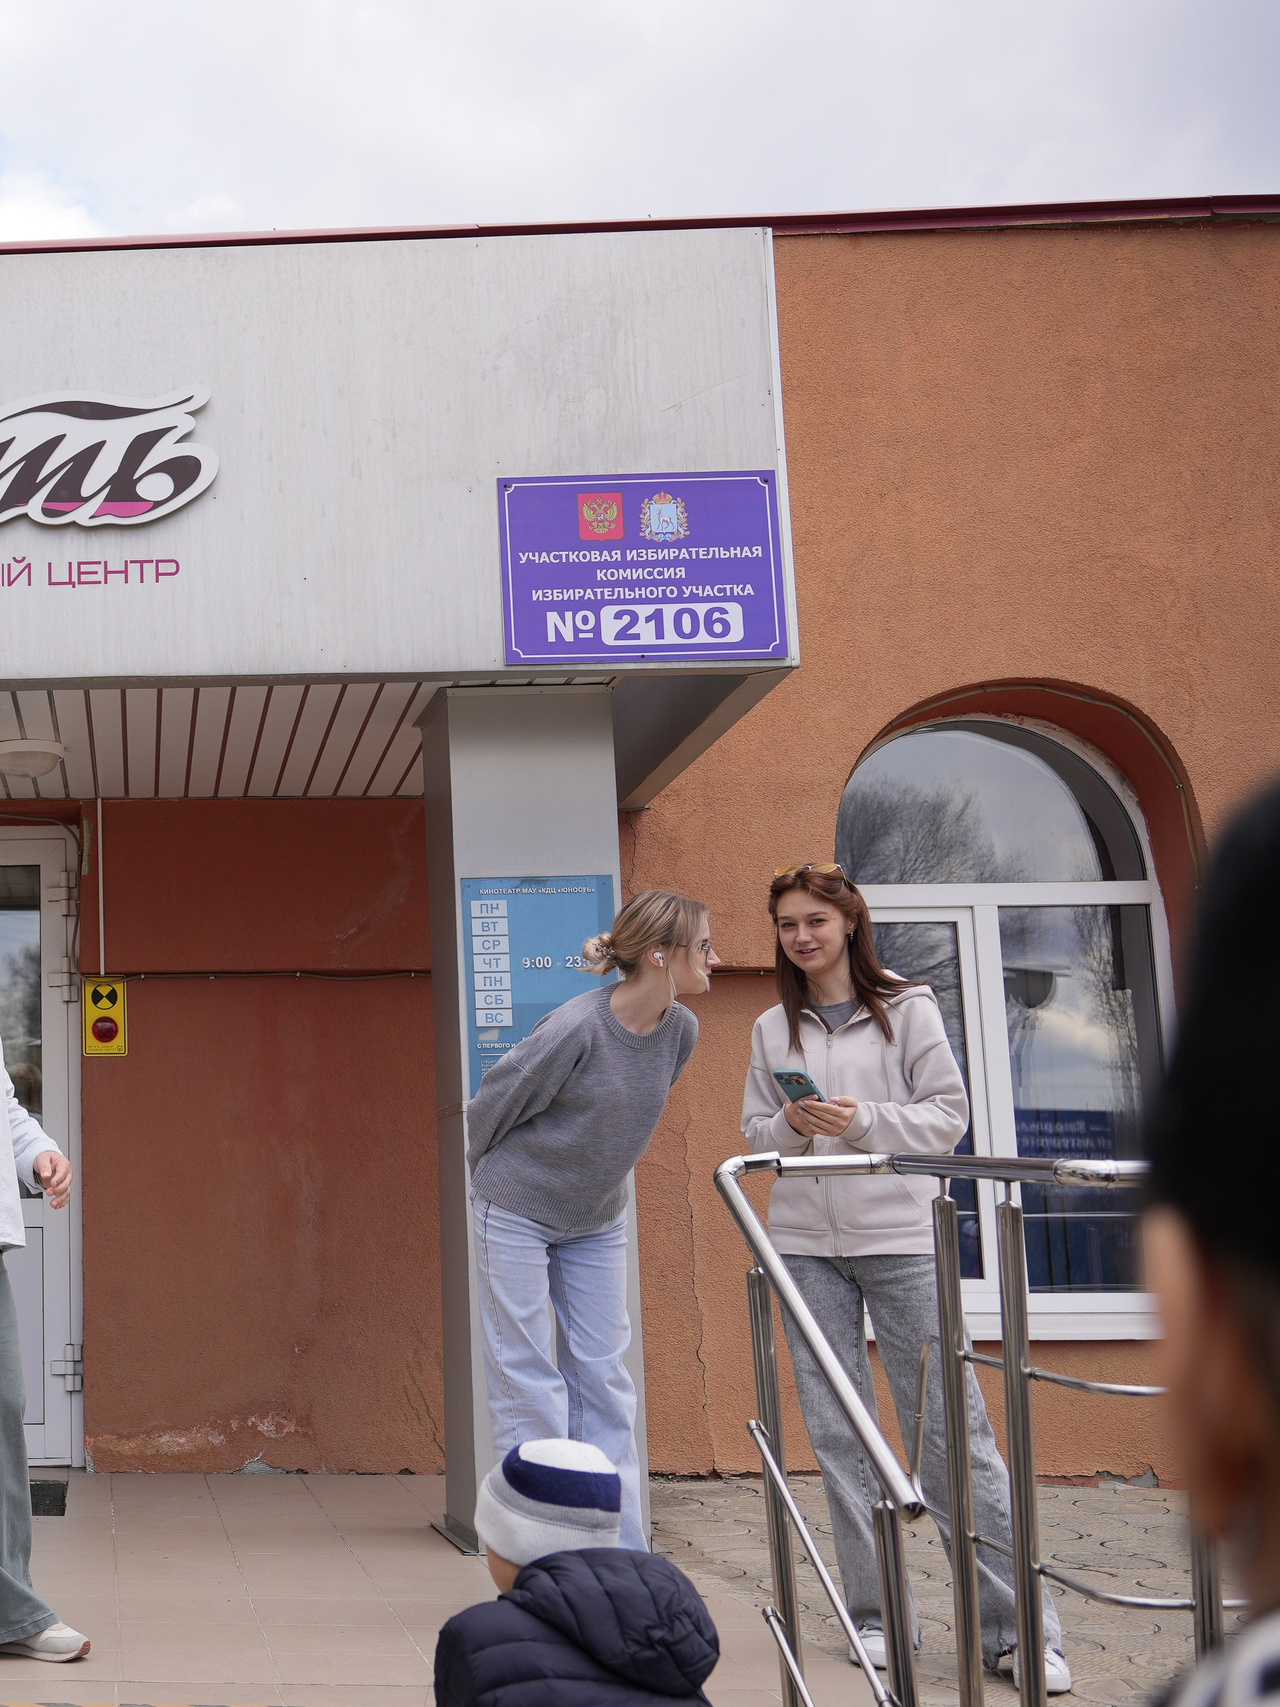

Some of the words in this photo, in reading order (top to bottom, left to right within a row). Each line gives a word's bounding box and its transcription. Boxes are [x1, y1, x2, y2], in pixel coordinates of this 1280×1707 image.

[518, 550, 622, 564] УЧАСТКОВАЯ
[626, 546, 763, 561] ИЗБИРАТЕЛЬНАЯ
[47, 558, 181, 589] ЦЕНТР
[596, 567, 686, 581] КОМИССИЯ
[531, 587, 678, 601] ИЗБИРАТЕЛЬНОГО
[682, 584, 755, 598] УЧАСТКА
[545, 610, 596, 643] №
[612, 606, 732, 641] 2106
[480, 903, 499, 914] ПН
[481, 921, 499, 932] ВТ
[482, 939, 501, 950] СР
[483, 957, 501, 968] ЧТ
[522, 956, 552, 968] 9:00
[483, 976, 503, 987] ПН
[484, 994, 504, 1005] СБ
[485, 1012, 504, 1024] ВС
